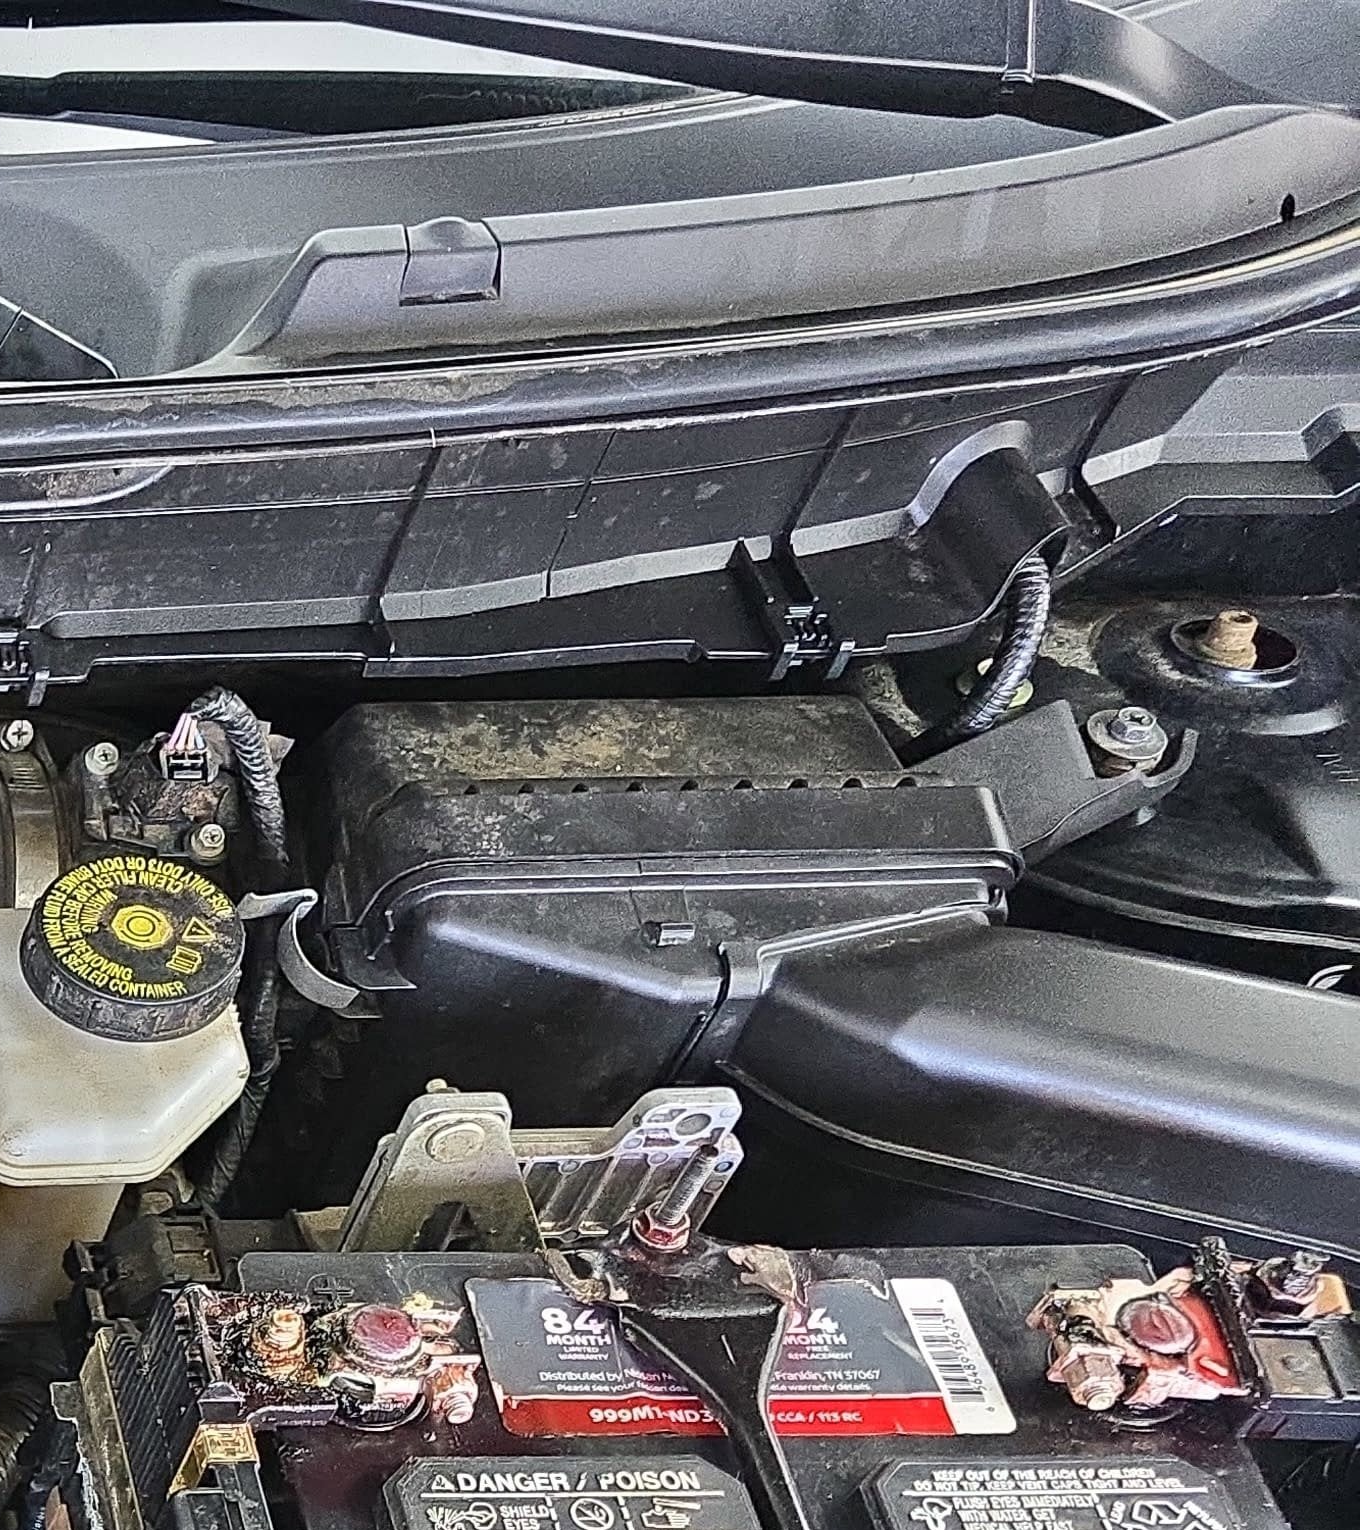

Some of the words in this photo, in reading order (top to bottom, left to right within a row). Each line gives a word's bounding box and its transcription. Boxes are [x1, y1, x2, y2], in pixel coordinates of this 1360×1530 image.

[89, 856, 125, 875] DOT4
[125, 856, 146, 870] OR
[148, 858, 185, 879] DOT3
[54, 865, 94, 894] BRAKE
[90, 870, 137, 889] FILLER
[139, 870, 184, 894] CLEAN
[180, 871, 215, 897] ONLY
[72, 882, 98, 903] CAP
[43, 889, 67, 918] FLUID
[80, 888, 118, 934] WARNING
[207, 893, 235, 919] USE
[61, 899, 83, 940] BEFORE
[42, 918, 67, 948] FROM
[53, 947, 71, 958] A
[69, 938, 133, 980] REMOVING
[62, 953, 109, 988] SEALED
[109, 979, 188, 999] CONTAINER
[541, 1307, 605, 1335] 84
[786, 1307, 839, 1334] 24
[546, 1335, 612, 1346] MONTH
[782, 1333, 848, 1345] MONTH
[558, 1353, 609, 1361] WARRANTY
[787, 1352, 853, 1360] REPLACEMENT
[539, 1371, 605, 1382] Distributed
[606, 1371, 622, 1383] by
[844, 1369, 880, 1380] 37067
[556, 1383, 591, 1392] Please
[592, 1384, 610, 1392] see
[610, 1381, 635, 1395] your
[787, 1384, 835, 1394] warranty
[589, 1405, 716, 1424] 999M1-ND3
[779, 1413, 805, 1422] CCA
[842, 1413, 863, 1422] RC
[457, 1472, 571, 1491] DANGER
[597, 1471, 701, 1490] POISON
[932, 1470, 964, 1482] KEEP
[965, 1470, 990, 1481] OUT
[992, 1469, 1009, 1481] OF
[1011, 1470, 1037, 1481] THE
[1038, 1469, 1077, 1480] REACH
[1079, 1468, 1095, 1479] OF
[1098, 1468, 1156, 1479] CHILDREN
[913, 1481, 932, 1491] DO
[933, 1481, 959, 1491] NOT
[985, 1481, 1015, 1490] KEEP
[1016, 1481, 1048, 1490] VENT
[1050, 1480, 1082, 1490] CAPS
[1085, 1479, 1118, 1489] TIGHT
[1122, 1479, 1147, 1488] AND
[500, 1505, 550, 1518] SHIELD
[952, 1497, 990, 1510] FLUSH
[990, 1496, 1021, 1509] EYES
[1021, 1495, 1096, 1508] IMMEDIATELY
[503, 1519, 540, 1530] EYES
[957, 1510, 989, 1522] WITH
[1032, 1509, 1056, 1521] GET
